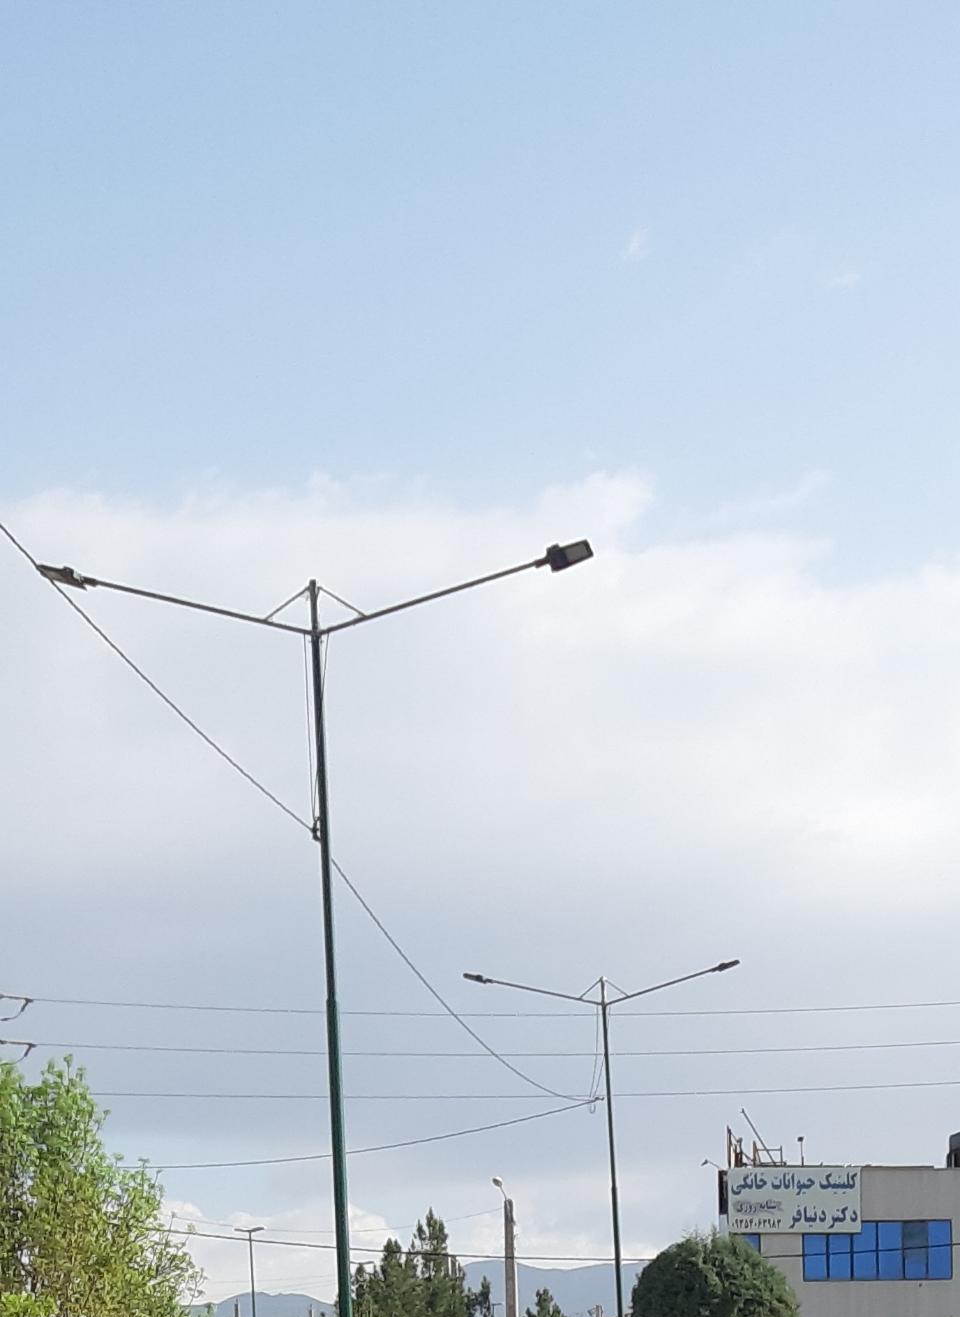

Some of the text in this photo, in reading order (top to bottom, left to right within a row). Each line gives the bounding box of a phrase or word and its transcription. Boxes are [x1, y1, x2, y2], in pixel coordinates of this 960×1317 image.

[731, 1171, 858, 1196] کلینیک حیوانات خانگی
[788, 1205, 858, 1229] دکتر دنیافر
